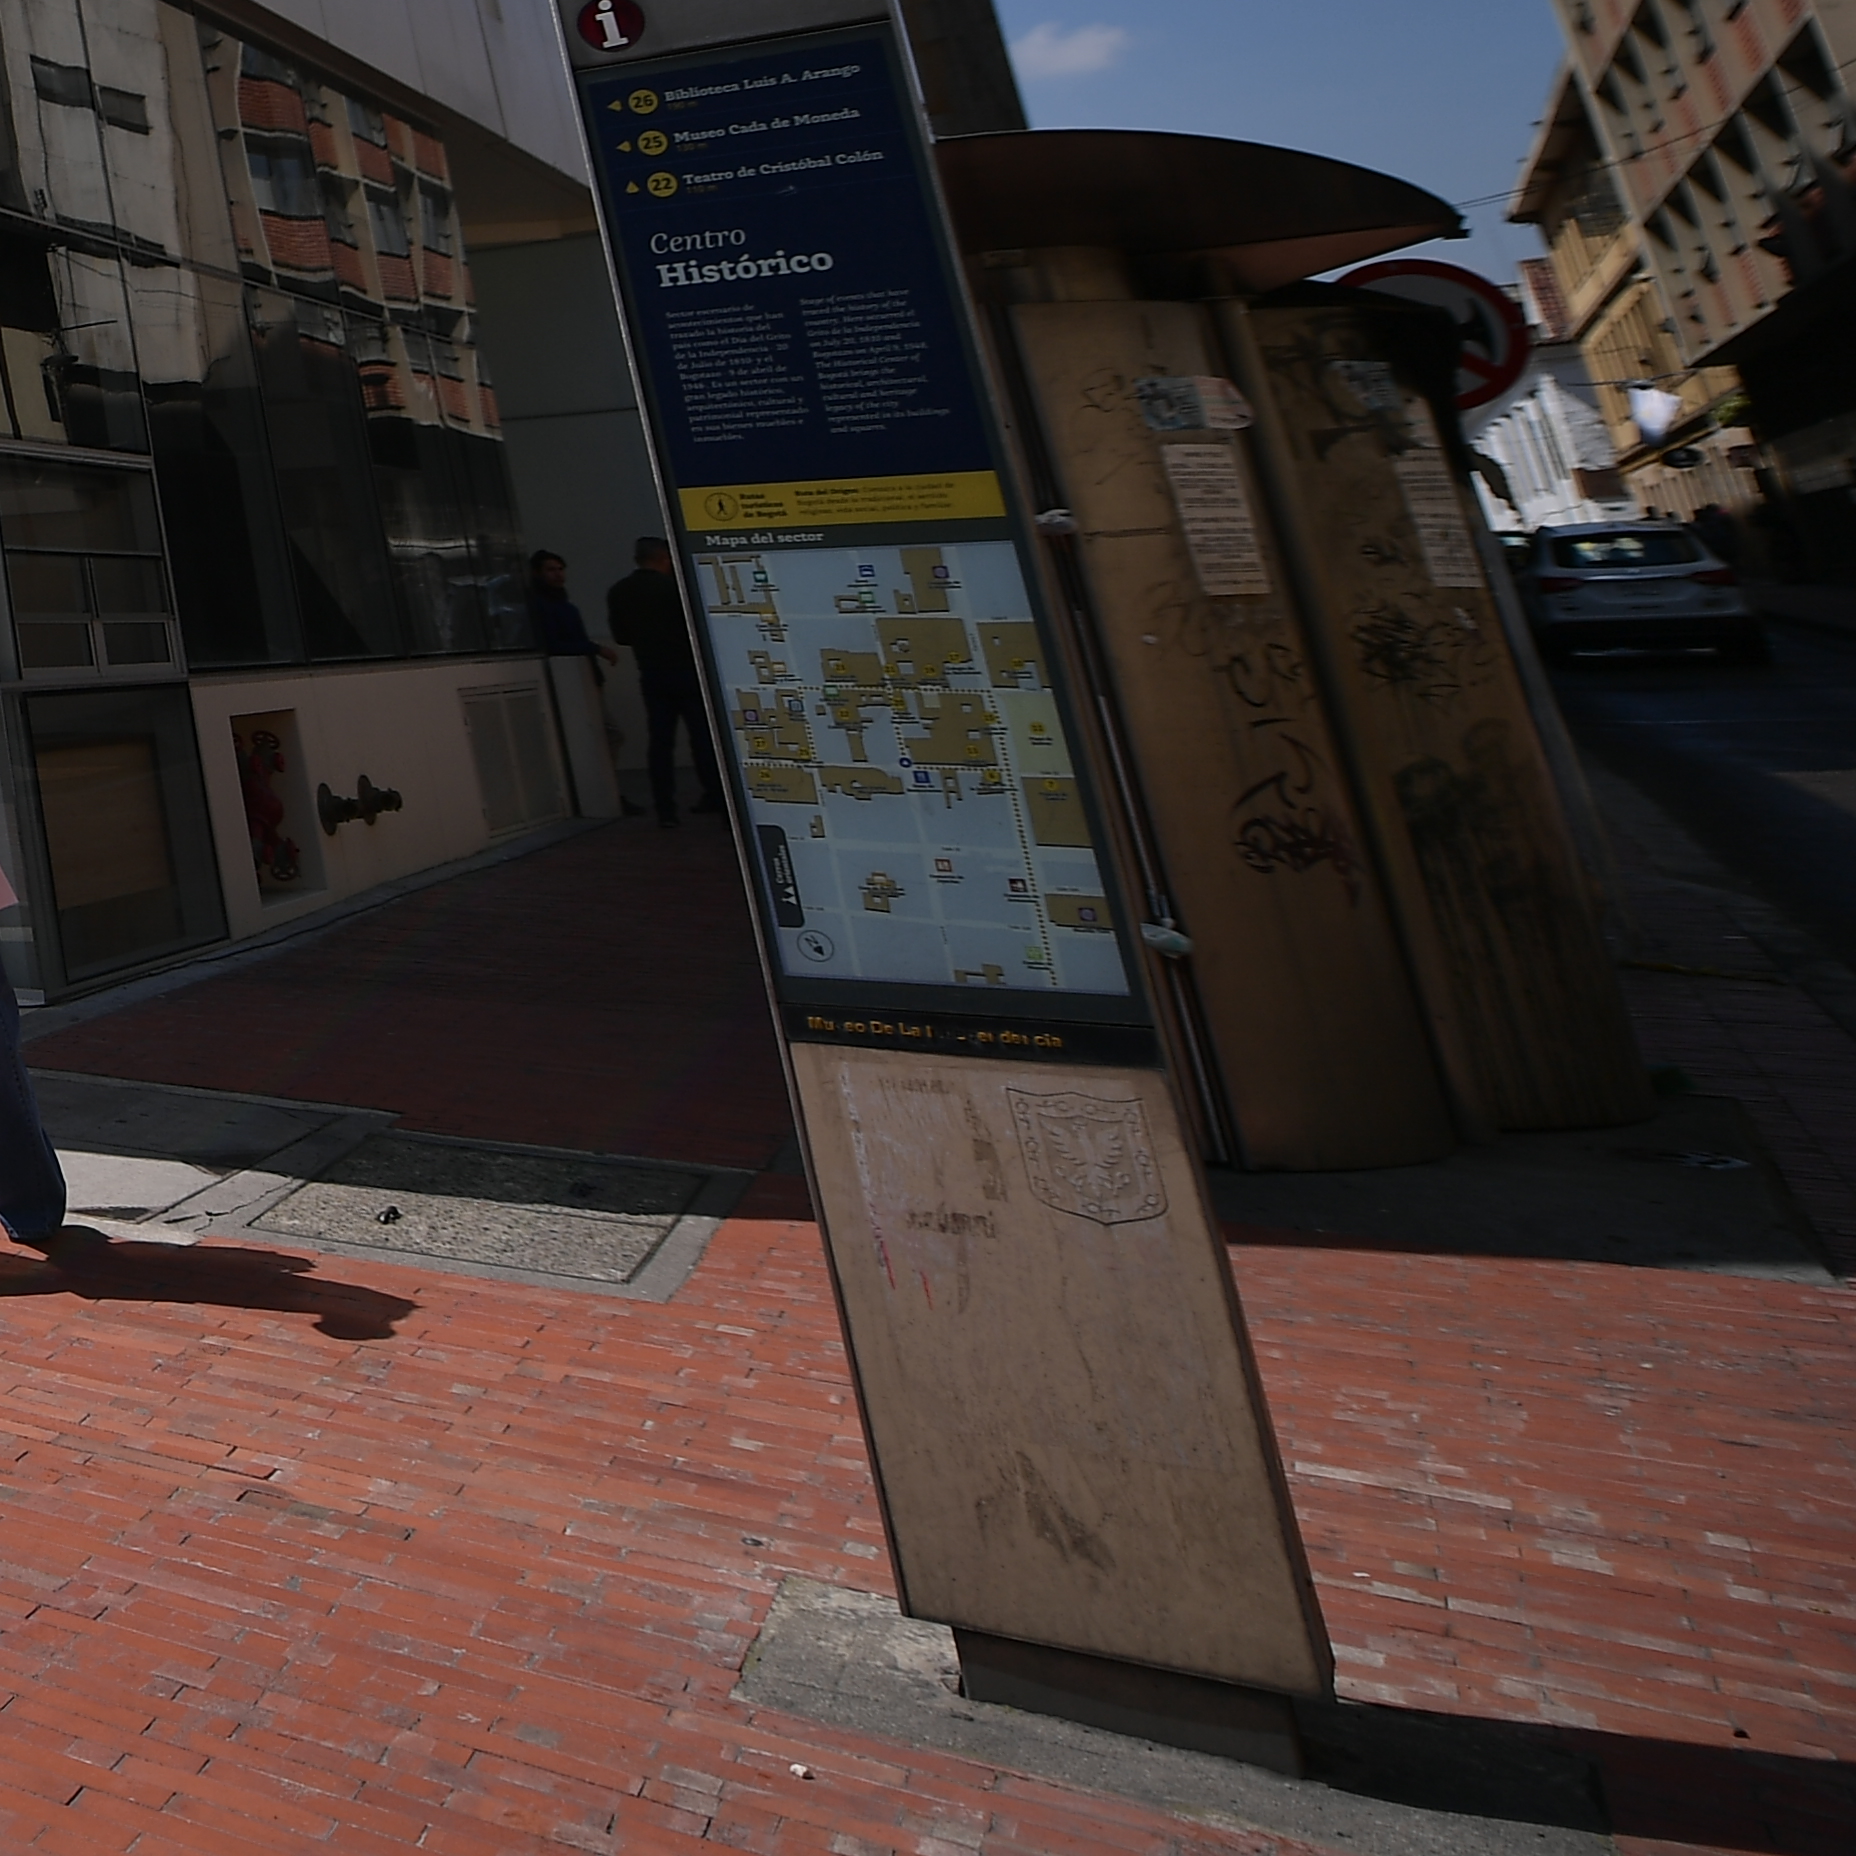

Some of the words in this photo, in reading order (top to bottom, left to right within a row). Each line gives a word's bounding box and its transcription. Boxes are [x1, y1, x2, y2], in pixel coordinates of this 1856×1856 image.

[634, 95, 652, 108] 26
[664, 83, 740, 101] Biblioteca
[743, 76, 777, 89] Luis
[780, 73, 798, 84] A.
[801, 65, 860, 81] Arango
[642, 137, 662, 149] 25
[673, 129, 726, 143] Museo
[771, 118, 790, 129] de
[793, 108, 860, 126] Moneda
[652, 178, 672, 191] 22
[682, 171, 734, 184] Teatro
[737, 166, 756, 178] de
[759, 155, 832, 174] Cristóbal
[835, 150, 884, 164] Colón
[651, 225, 746, 257] Centro
[656, 246, 834, 288] Histórico
[705, 535, 748, 548] Mapa
[750, 532, 774, 544] del
[777, 533, 824, 543] sector
[807, 1016, 865, 1032] Mueo
[898, 1022, 920, 1036] La
